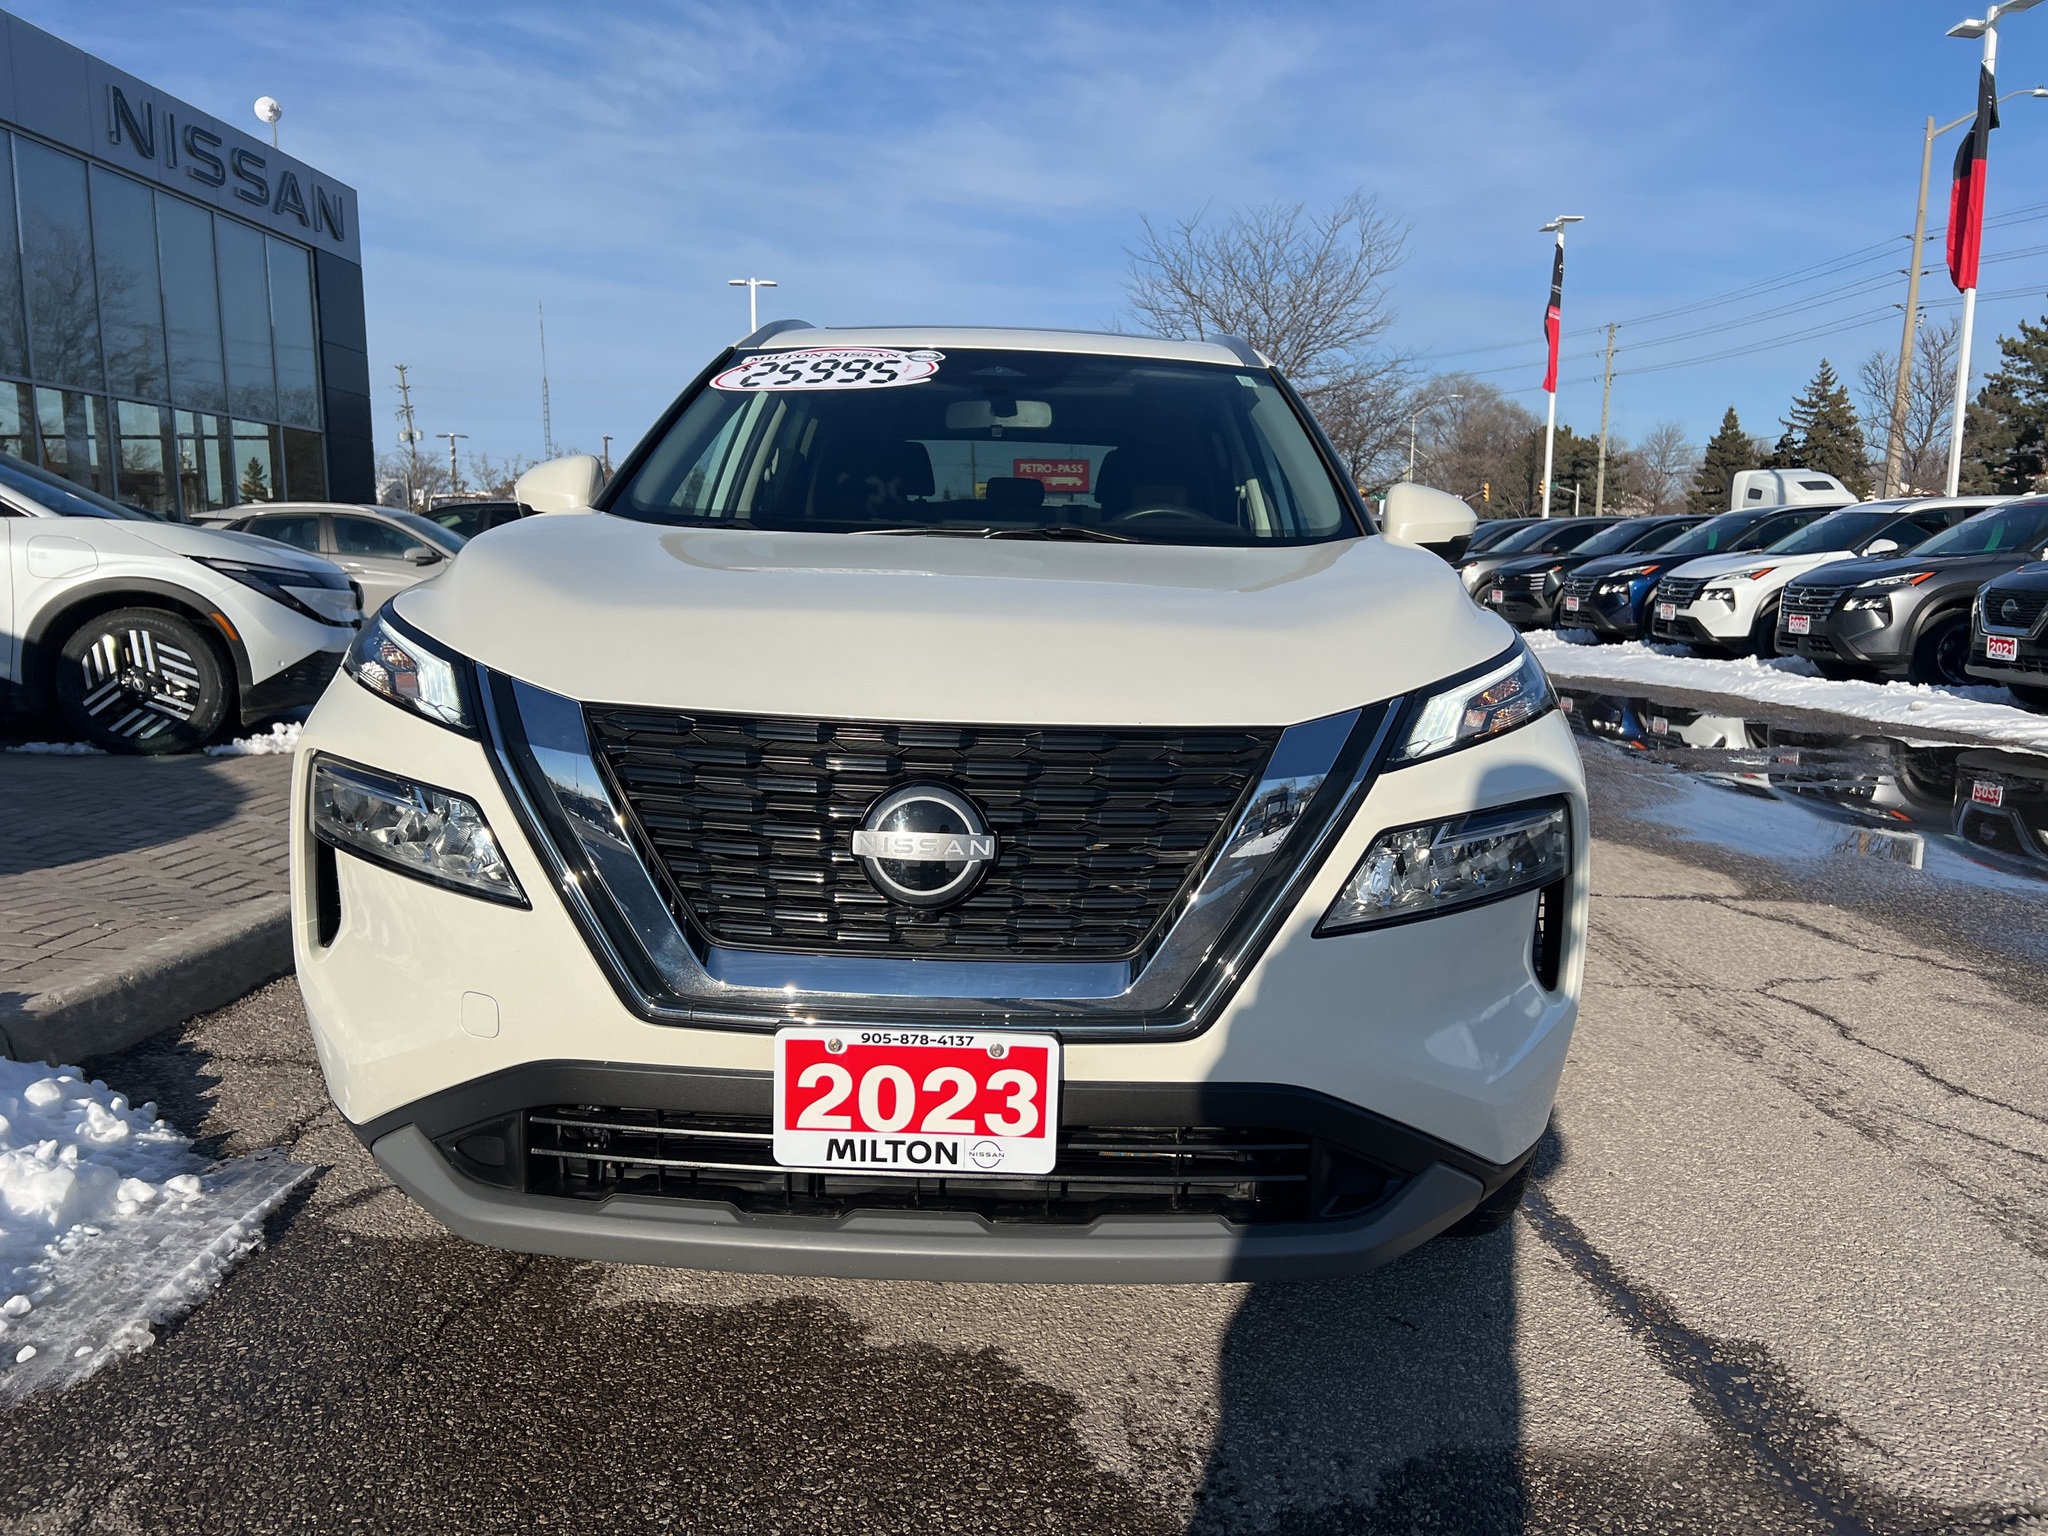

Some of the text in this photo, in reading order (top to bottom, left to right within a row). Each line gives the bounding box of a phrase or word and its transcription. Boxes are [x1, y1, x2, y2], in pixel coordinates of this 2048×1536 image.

[107, 84, 345, 241] NISSAN
[750, 352, 901, 363] MILTON NISSAN
[1019, 463, 1084, 474] PETRO-PASS
[1989, 641, 2014, 655] 2021
[857, 833, 990, 856] NISSAN
[860, 1032, 975, 1047] 905-878-4137
[796, 1062, 1039, 1137] 2023
[825, 1138, 959, 1165] MILTON
[968, 1150, 1006, 1159] NISSAN
